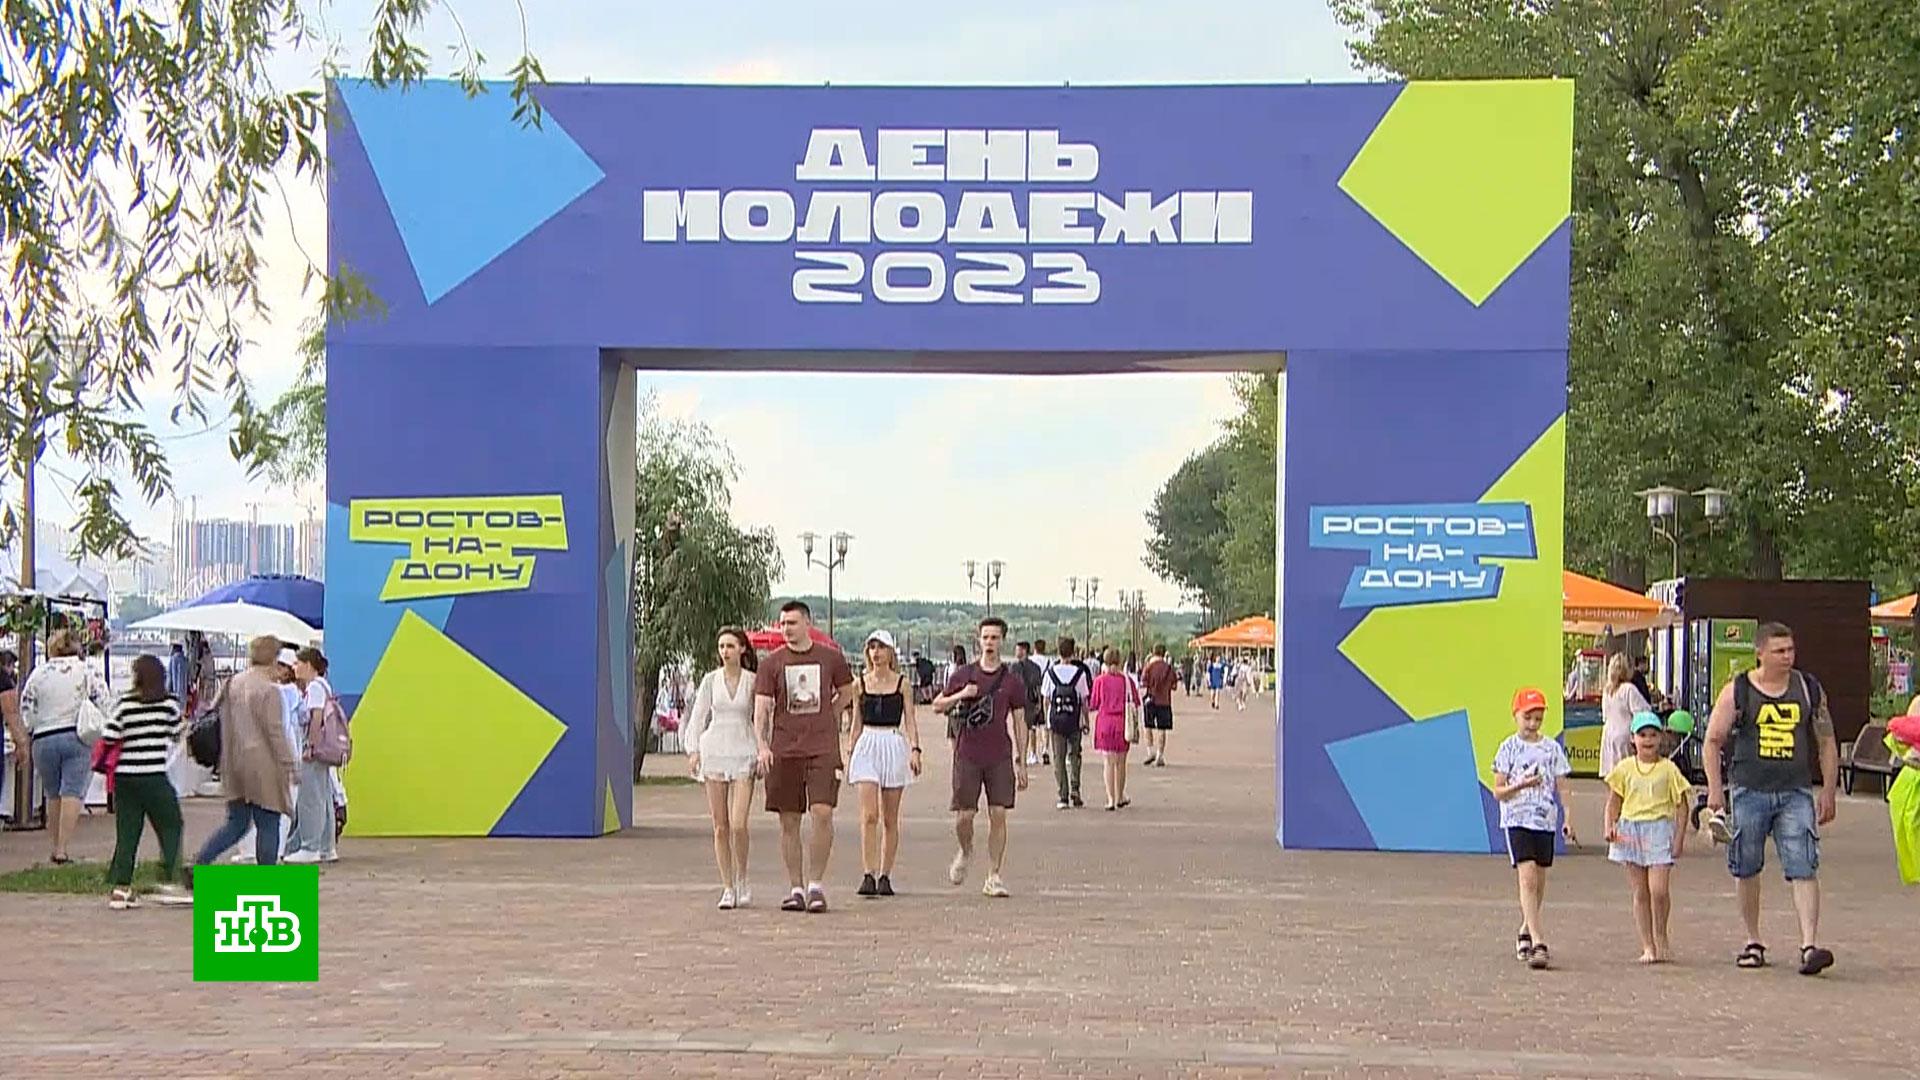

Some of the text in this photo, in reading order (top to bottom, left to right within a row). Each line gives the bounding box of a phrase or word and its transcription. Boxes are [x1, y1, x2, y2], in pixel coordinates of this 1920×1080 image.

[795, 128, 1100, 181] ДЕНЬ
[643, 190, 1254, 244] МОЛОДЕЖИ
[792, 252, 1101, 305] 2023
[364, 510, 562, 528] РОСТОВ-
[1323, 516, 1526, 535] РОСТОВ-
[425, 537, 502, 554] НА-
[1384, 543, 1465, 562] НА-
[400, 563, 525, 580] ДОНУ
[1360, 569, 1488, 588] ДОНУ
